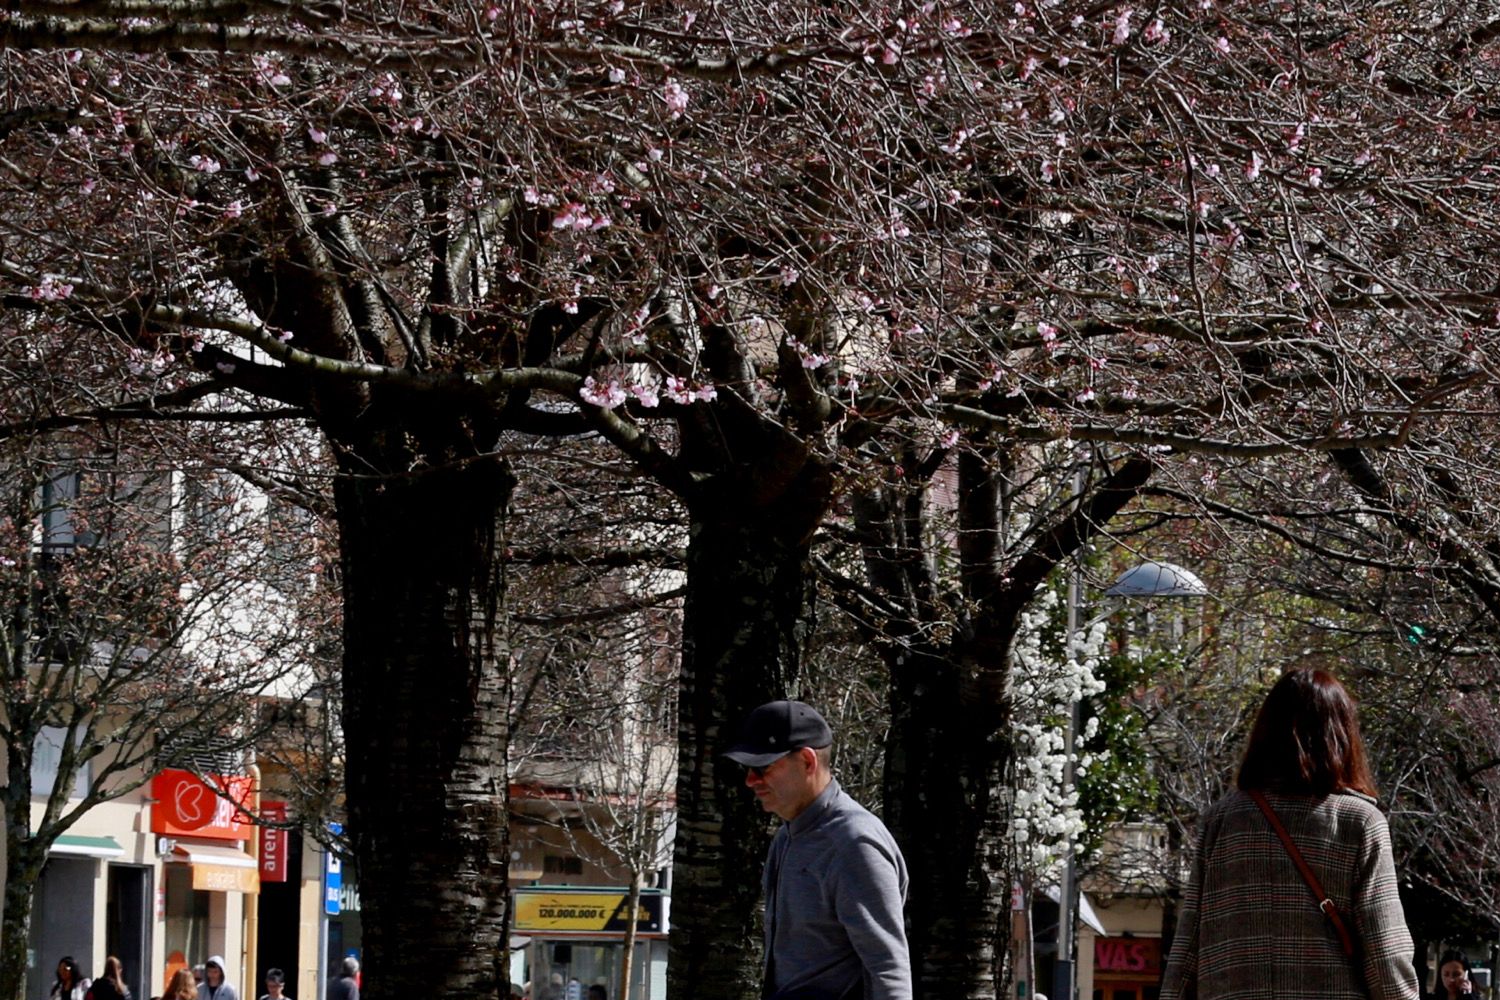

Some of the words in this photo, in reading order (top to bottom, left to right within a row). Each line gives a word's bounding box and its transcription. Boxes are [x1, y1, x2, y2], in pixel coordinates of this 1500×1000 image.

[539, 908, 597, 919] 120.000.000
[598, 909, 606, 919] €
[1096, 943, 1145, 971] VAS
